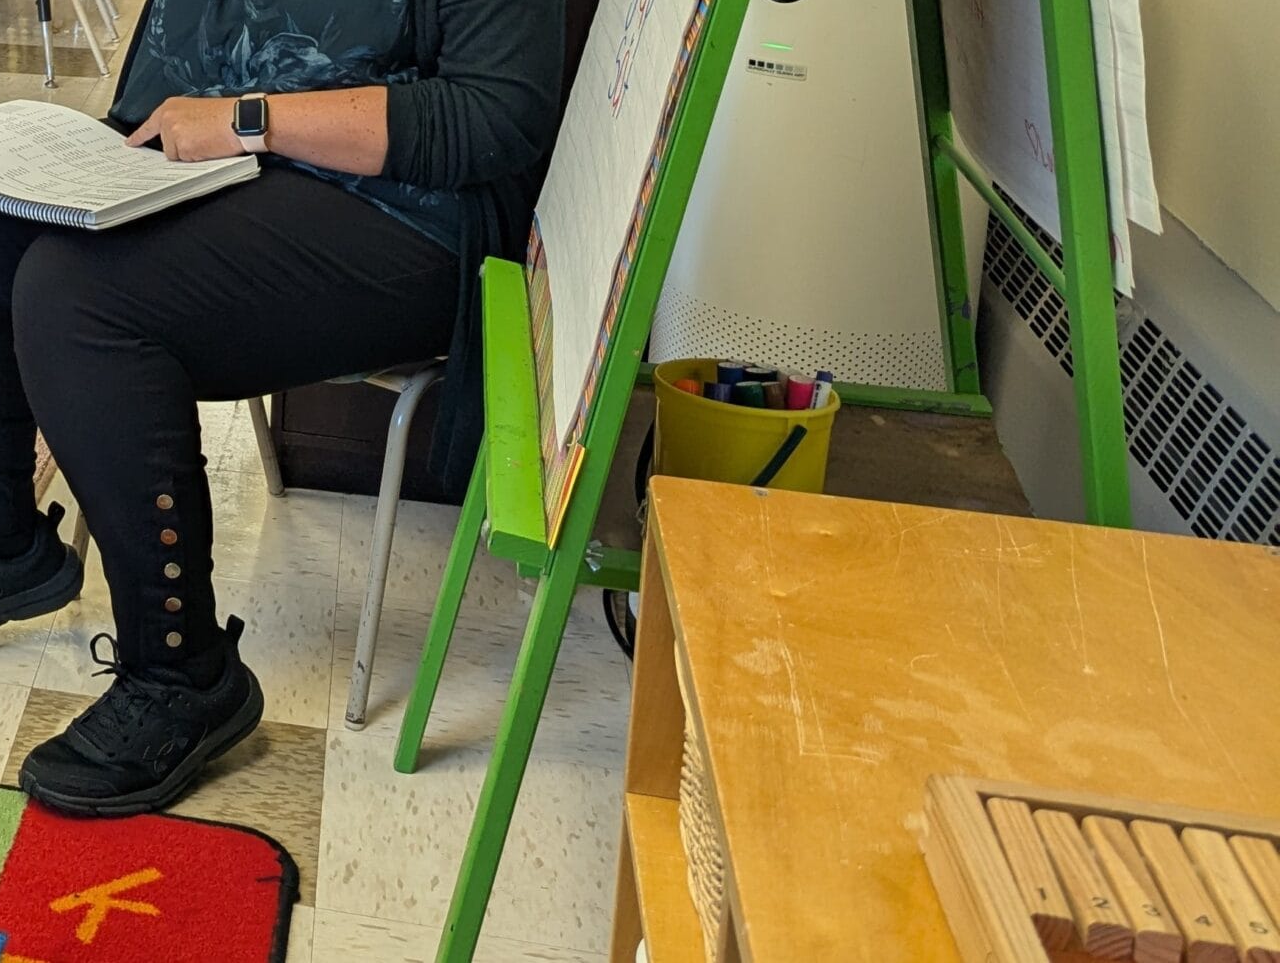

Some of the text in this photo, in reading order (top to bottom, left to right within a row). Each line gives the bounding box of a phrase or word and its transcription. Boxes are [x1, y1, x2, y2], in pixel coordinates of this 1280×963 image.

[1038, 887, 1048, 901] 1
[1091, 896, 1111, 910] 2
[1141, 903, 1162, 917] 3
[1193, 914, 1214, 927] 4
[1248, 920, 1269, 935] 5
